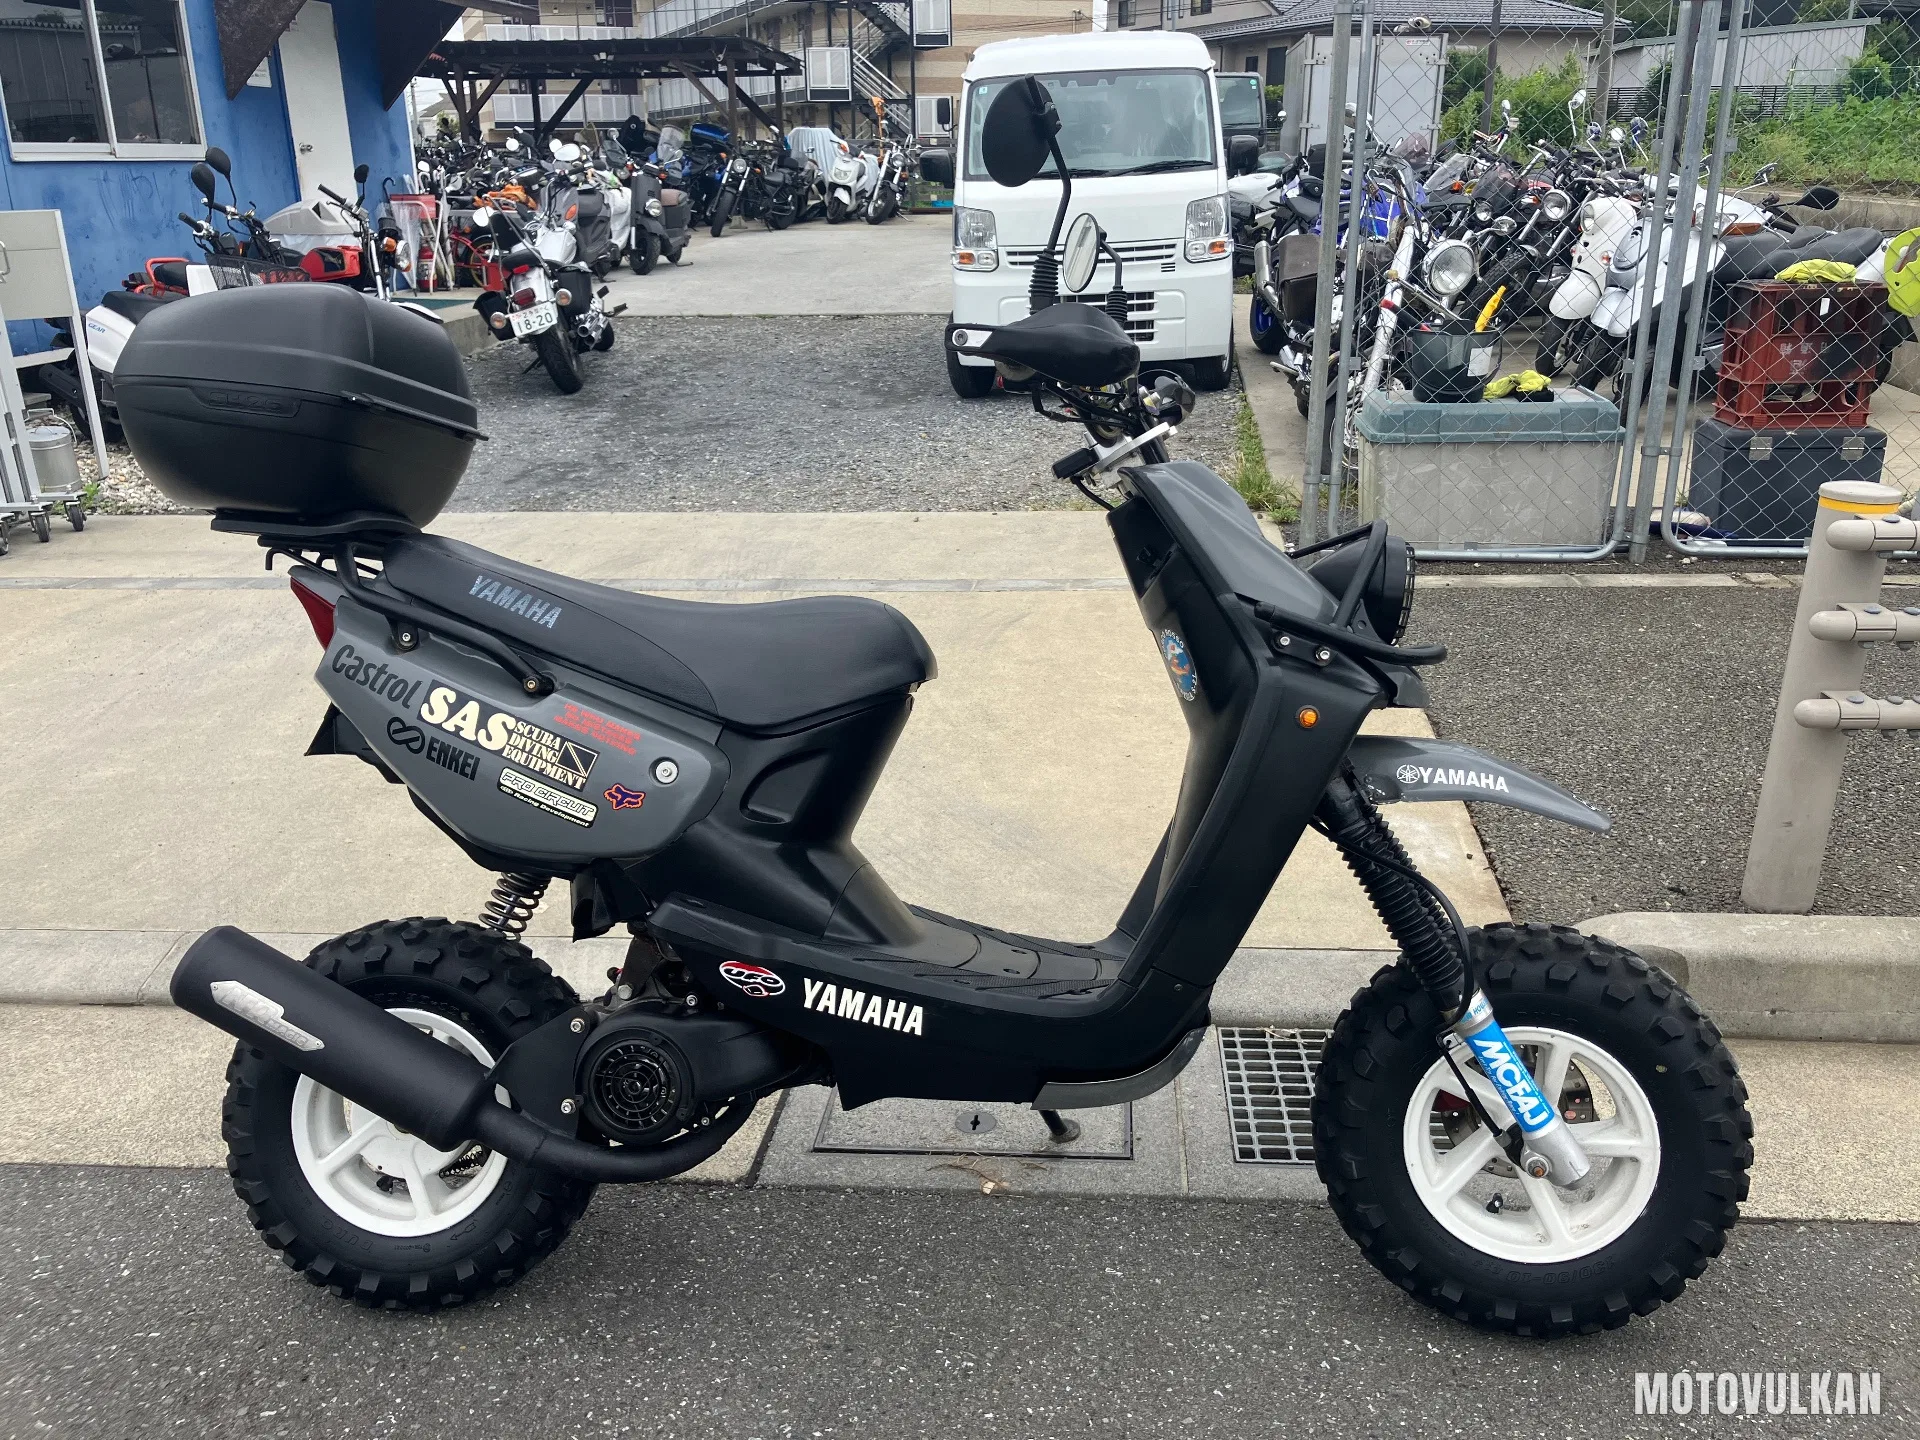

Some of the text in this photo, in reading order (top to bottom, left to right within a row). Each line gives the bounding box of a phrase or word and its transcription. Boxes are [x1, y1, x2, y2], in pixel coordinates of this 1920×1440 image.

[88, 322, 106, 334] GEAR
[468, 575, 562, 629] YAMAHA
[332, 644, 423, 709] Castrol
[420, 687, 516, 751] SAS
[514, 721, 561, 751] SCUBA
[426, 736, 481, 781] ENKEI
[502, 744, 586, 790] EQUIPMENT
[508, 732, 560, 763] DIVING
[501, 771, 595, 816] PRO CIRCUIT
[1418, 766, 1509, 793] YAMAHA
[513, 792, 590, 827] Racing Development
[722, 966, 782, 988] UFO
[803, 977, 924, 1036] YAMAHA
